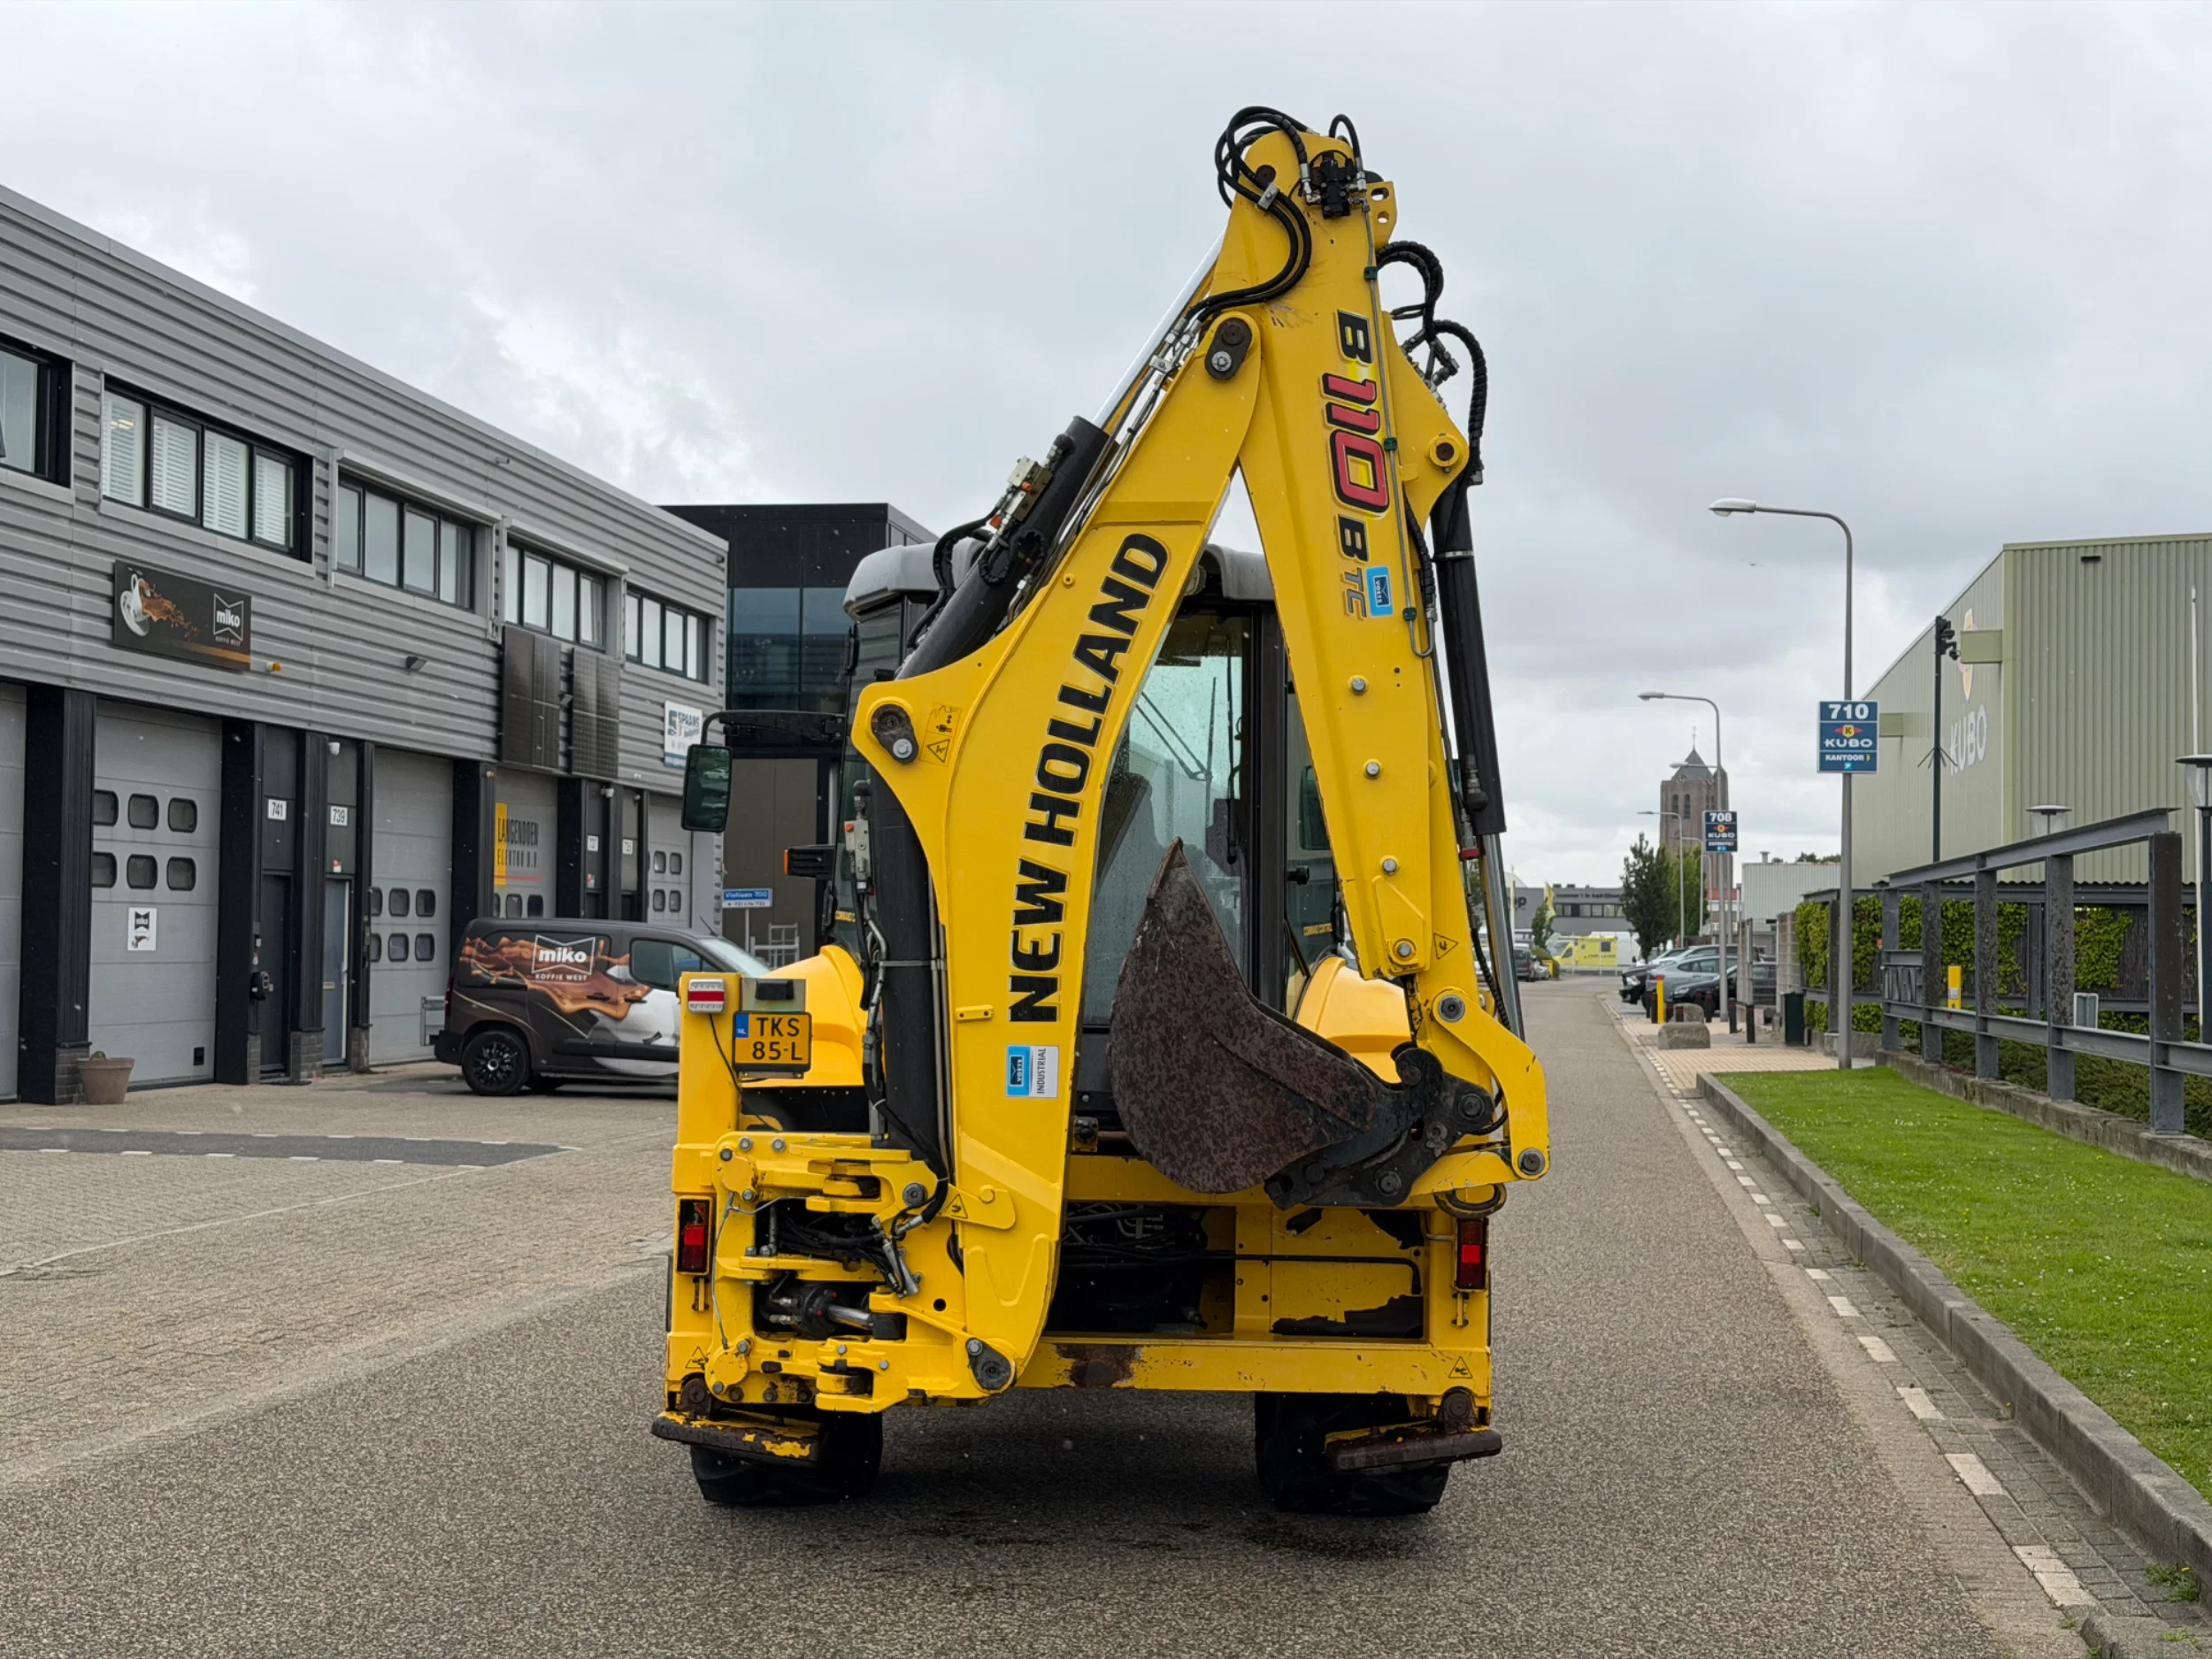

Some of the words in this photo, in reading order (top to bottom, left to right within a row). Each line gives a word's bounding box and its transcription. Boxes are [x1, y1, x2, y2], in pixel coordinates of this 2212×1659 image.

[216, 609, 241, 627] miko
[1024, 533, 1169, 848] HOLLAND
[1828, 703, 1869, 719] 710
[1824, 738, 1873, 748] KUBO
[1949, 704, 1987, 776] KUBO
[272, 802, 283, 818] 741
[333, 808, 345, 823] 739
[1709, 812, 1732, 823] 708
[1009, 857, 1069, 1023] NEW
[539, 947, 587, 963] miko
[757, 1018, 800, 1037] TKS
[752, 1041, 803, 1061] 85-L
[1036, 1048, 1046, 1094] INDUSTRIAL
